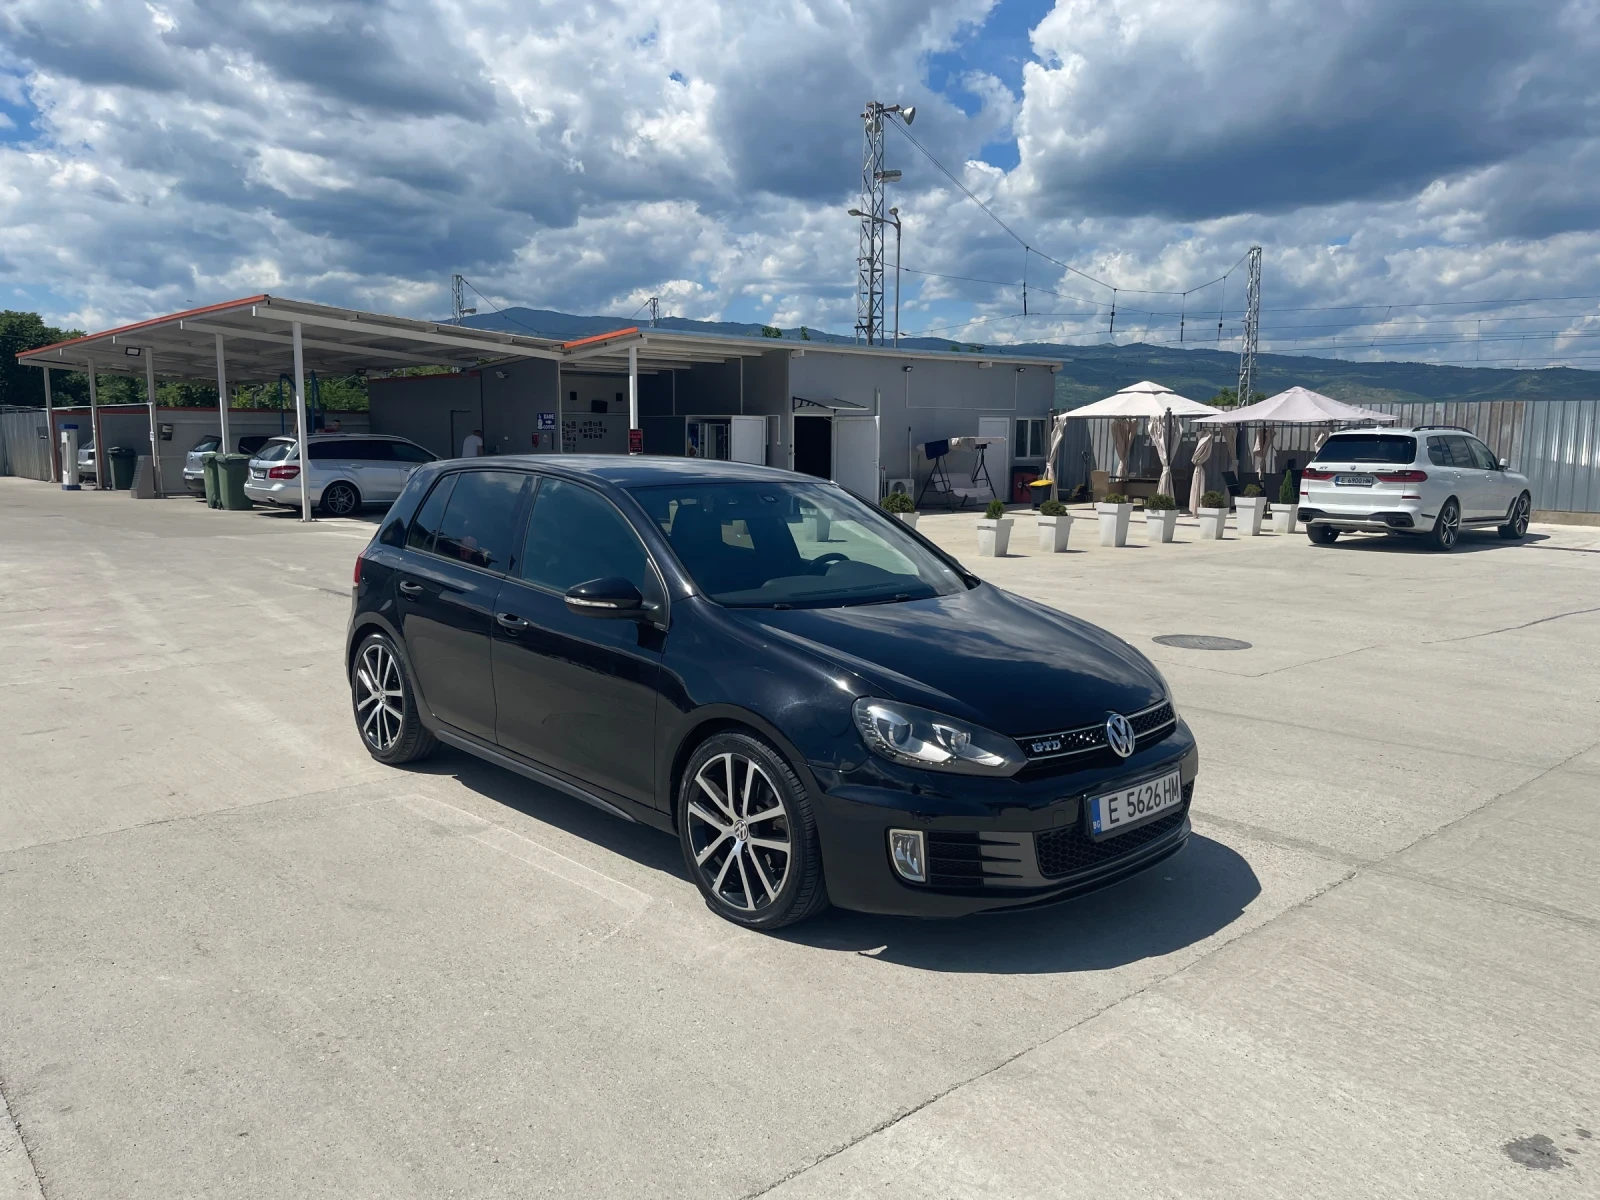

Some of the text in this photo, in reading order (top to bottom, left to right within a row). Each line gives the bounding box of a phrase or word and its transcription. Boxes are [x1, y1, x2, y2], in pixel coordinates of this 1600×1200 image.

[1031, 739, 1062, 753] GTD
[1108, 774, 1180, 824] E 5626 HM
[1092, 820, 1101, 829] BG
